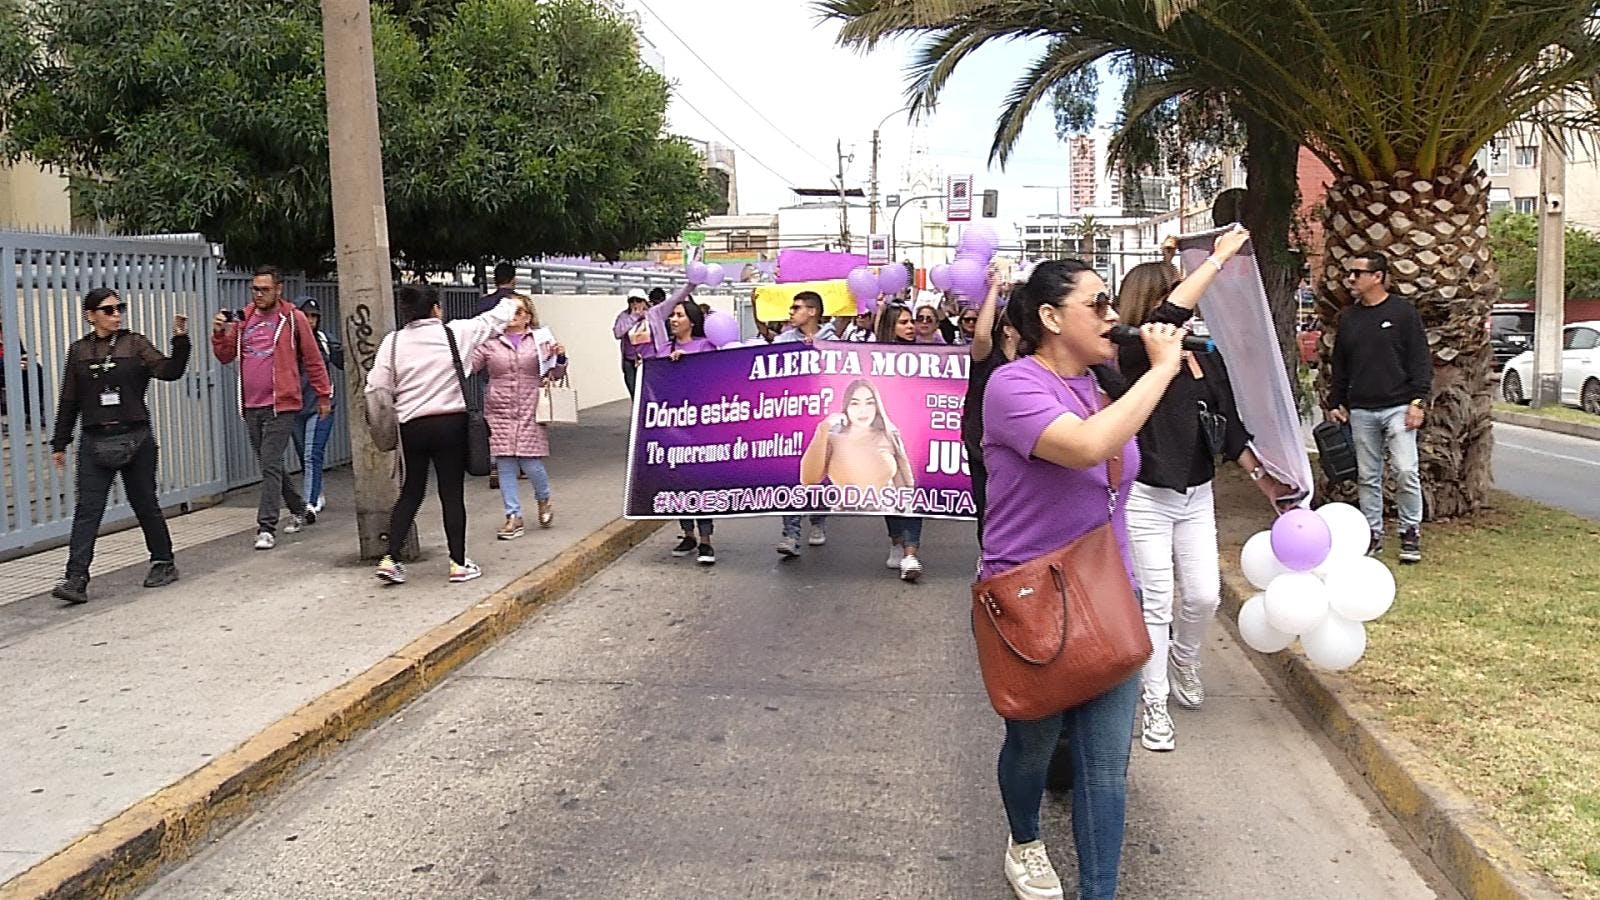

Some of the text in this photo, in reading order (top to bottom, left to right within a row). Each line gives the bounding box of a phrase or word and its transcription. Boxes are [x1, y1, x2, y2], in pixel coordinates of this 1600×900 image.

[749, 350, 861, 380] ALERTA
[645, 387, 834, 428] Dónde estás Javiera?
[931, 411, 961, 430] 26
[647, 431, 804, 469] Te queremos de vuelta!!
